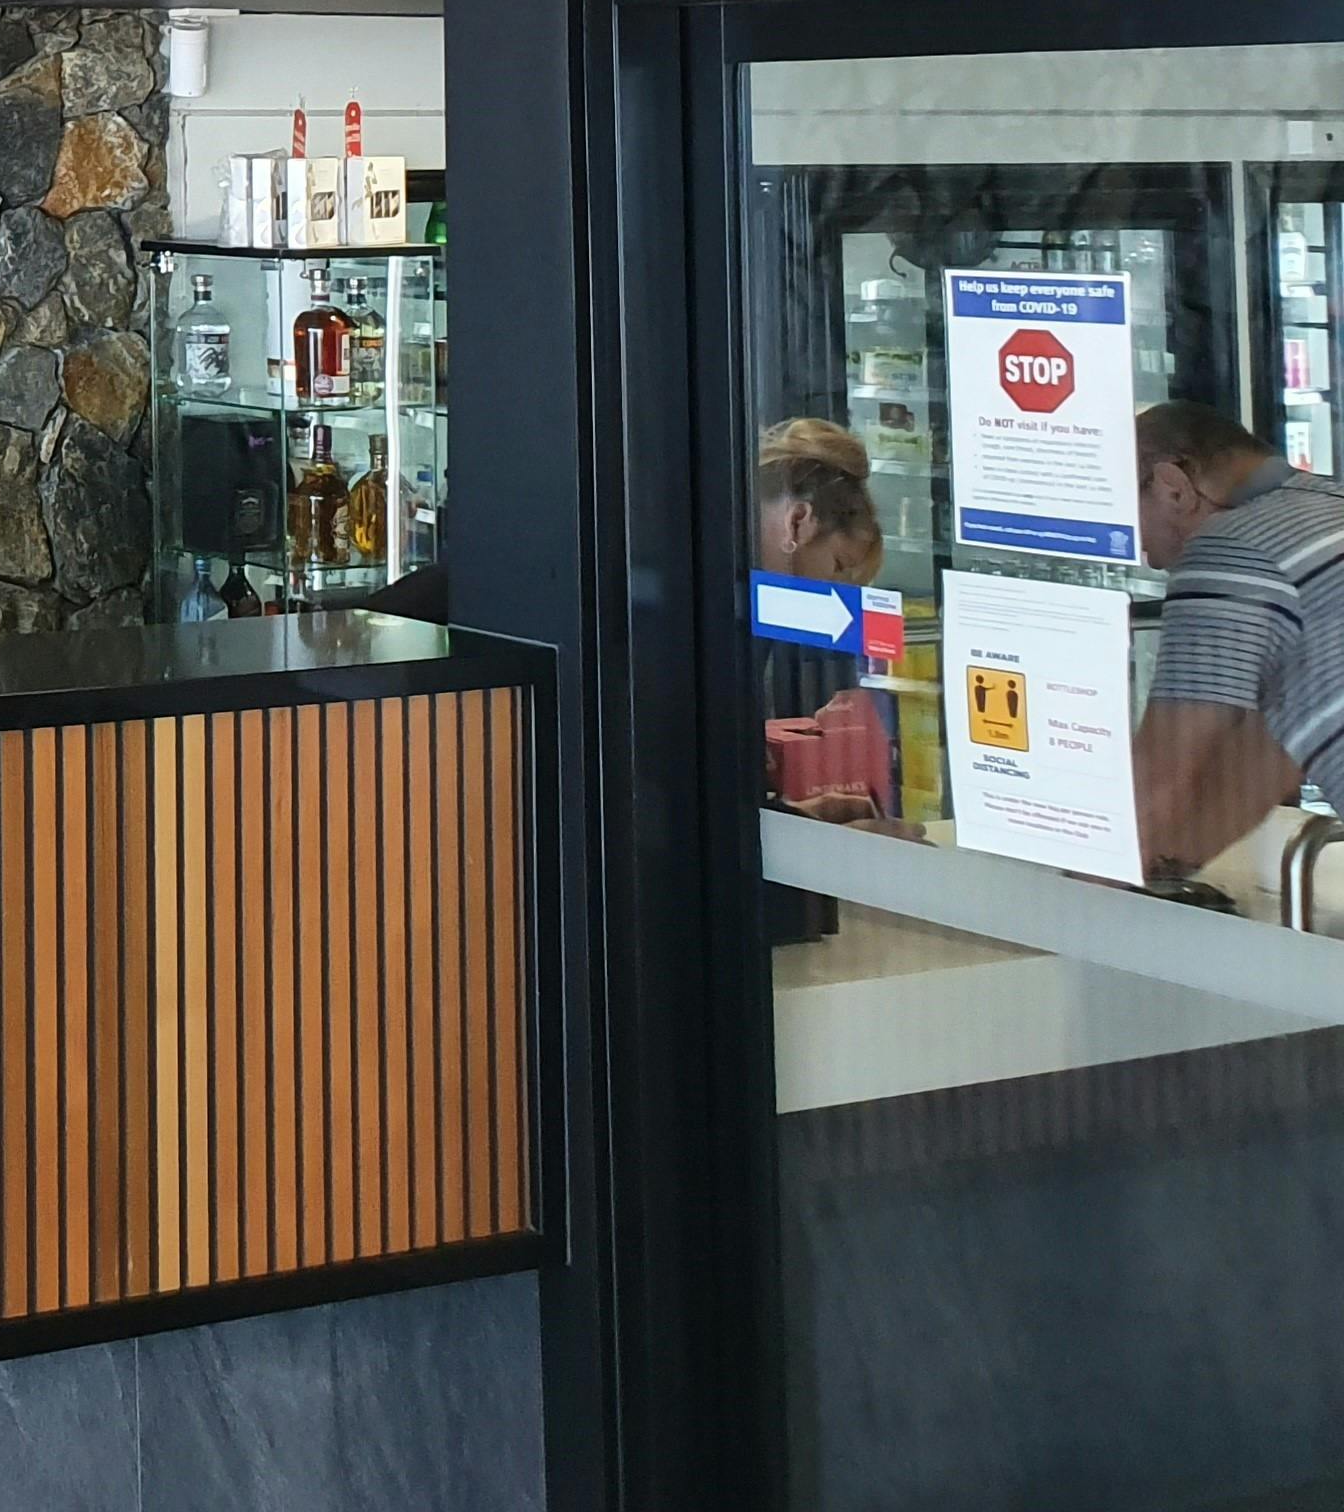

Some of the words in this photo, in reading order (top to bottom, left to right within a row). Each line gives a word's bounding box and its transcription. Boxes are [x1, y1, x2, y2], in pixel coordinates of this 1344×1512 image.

[959, 280, 984, 295] Help
[985, 283, 999, 293] us
[1000, 282, 1028, 297] keep
[1029, 285, 1086, 299] everyone
[1087, 285, 1115, 298] safe
[991, 300, 1017, 313] from
[1019, 301, 1078, 315] COVID-19
[1005, 354, 1068, 386] STOP
[978, 416, 992, 427] Do
[994, 418, 1014, 429] NOT
[1017, 419, 1038, 431] visit
[1040, 421, 1048, 432] if
[1051, 424, 1070, 435] you
[1073, 423, 1104, 437] have:
[970, 648, 983, 659] BE
[985, 651, 1020, 664] AWARE
[1048, 718, 1069, 730] Max
[1071, 722, 1112, 737] Capacity
[1057, 738, 1094, 753] PEOPLE
[972, 761, 1031, 780] DISTANCING
[983, 754, 1018, 768] SOCIAL
